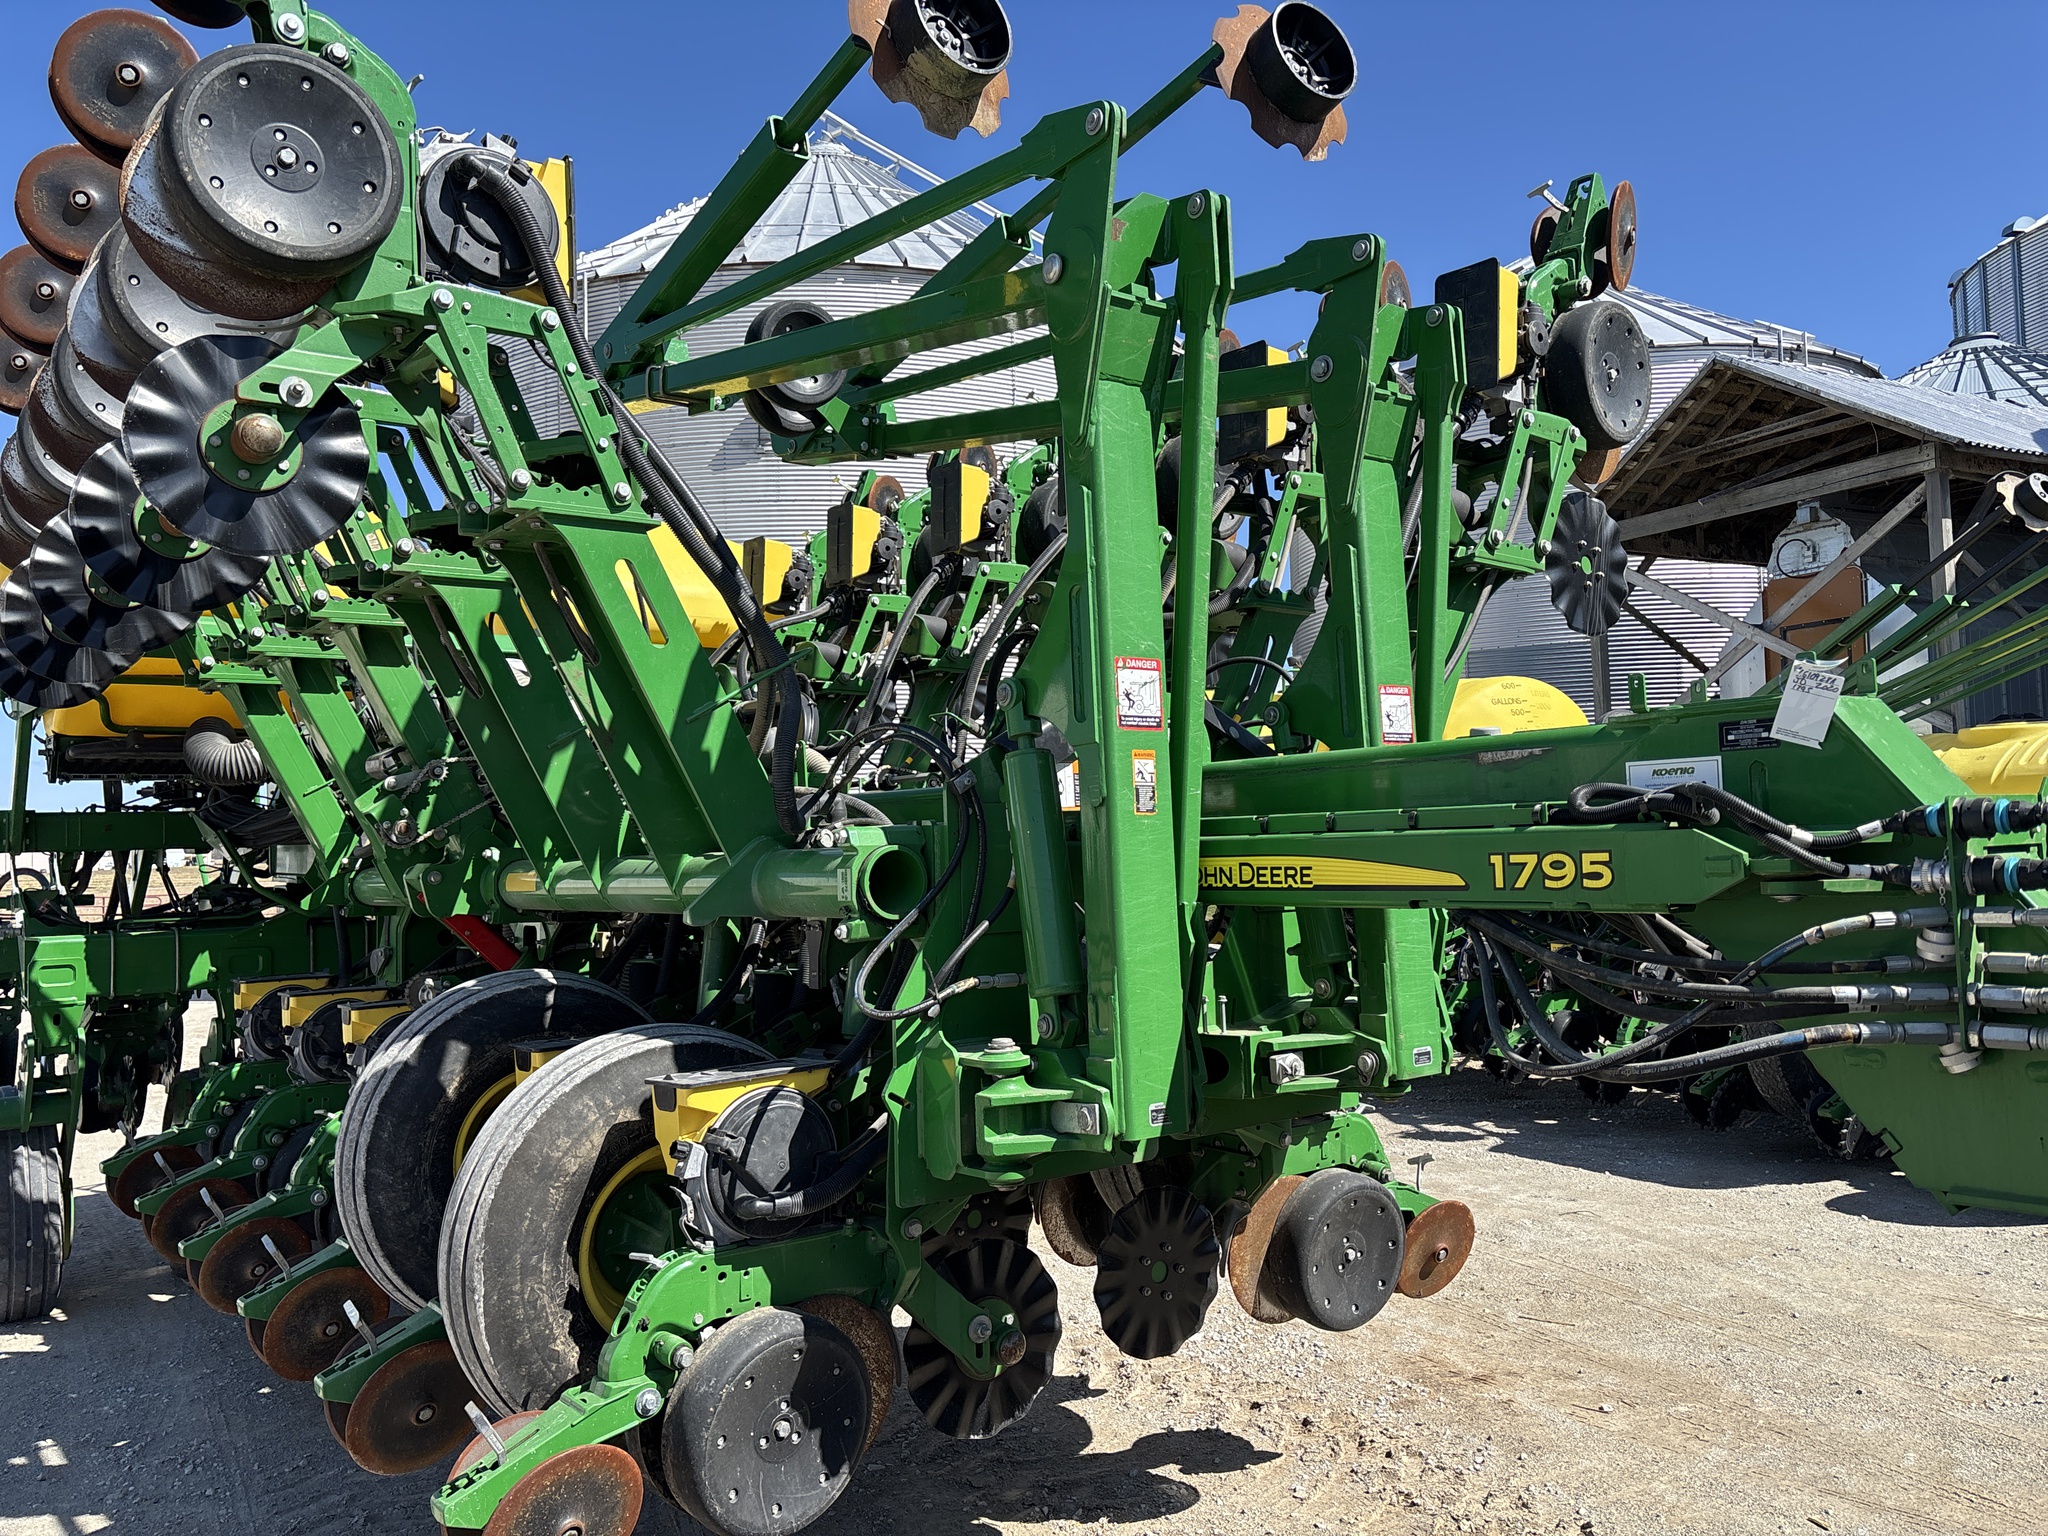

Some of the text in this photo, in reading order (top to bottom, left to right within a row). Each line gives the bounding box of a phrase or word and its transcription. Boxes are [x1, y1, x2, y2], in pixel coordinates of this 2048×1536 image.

[1125, 659, 1157, 669] DANGER
[1385, 686, 1409, 695] DANGER
[1501, 682, 1516, 690] 600
[1491, 697, 1522, 706] GALLONS
[1510, 708, 1525, 716] 500
[1238, 862, 1314, 886] DEERE
[1487, 850, 1615, 890] 1795
